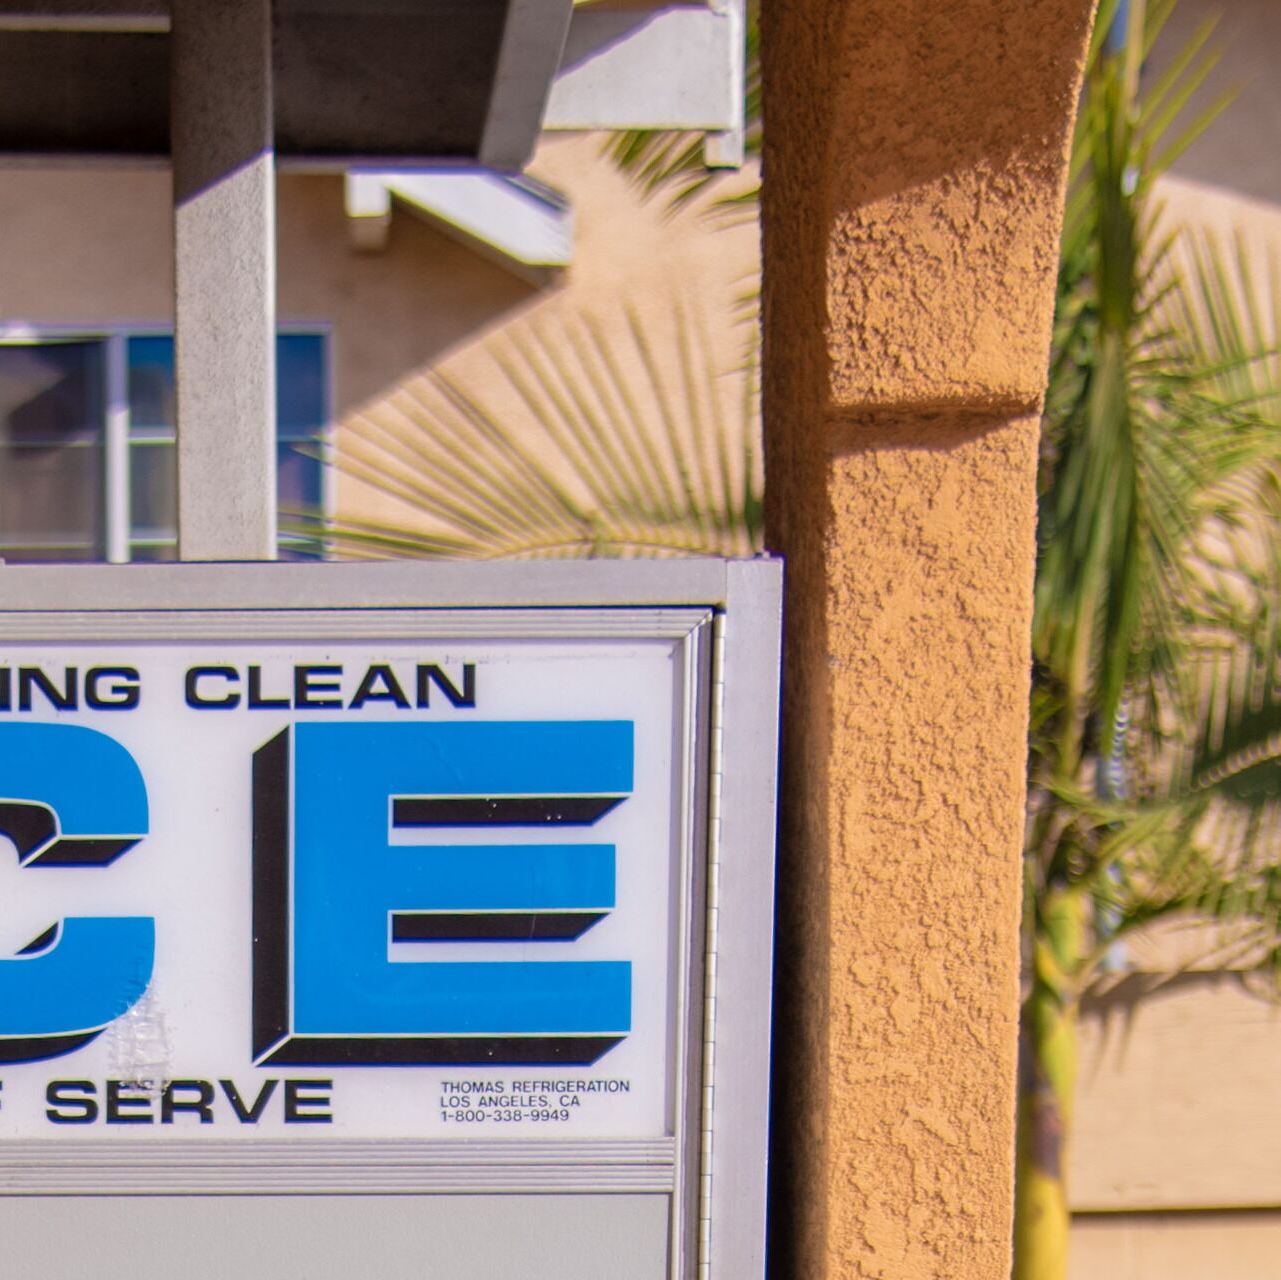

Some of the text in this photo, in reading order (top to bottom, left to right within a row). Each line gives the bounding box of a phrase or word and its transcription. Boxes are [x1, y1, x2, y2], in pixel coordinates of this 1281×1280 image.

[184, 663, 476, 711] CLEAN
[440, 1079, 630, 1094] THOMAS REFRIGERATION
[45, 1079, 333, 1126] SERVE
[440, 1094, 581, 1108] LOS ANGELES, CA
[441, 1108, 570, 1122] 1-800-338-9949
